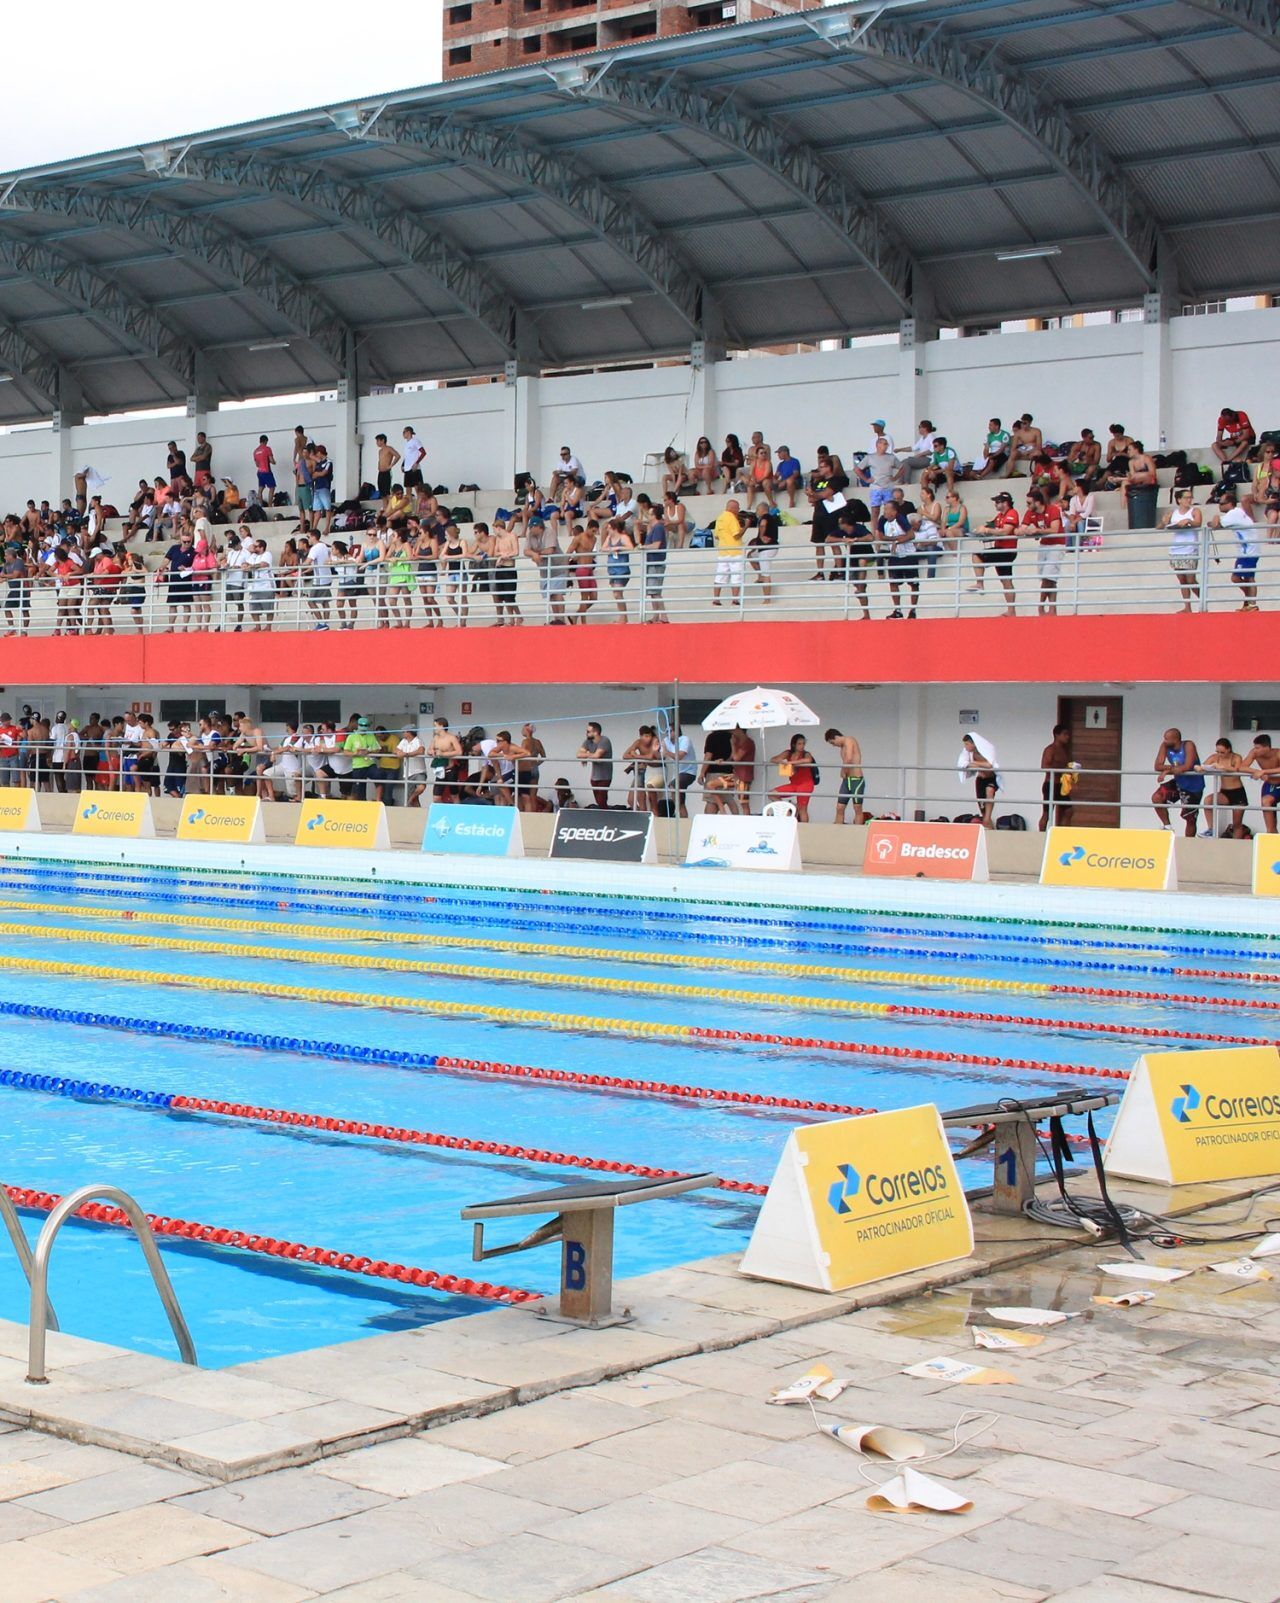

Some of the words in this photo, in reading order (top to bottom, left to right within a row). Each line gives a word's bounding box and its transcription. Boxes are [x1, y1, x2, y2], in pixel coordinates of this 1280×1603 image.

[97, 809, 135, 822] Correios
[204, 814, 246, 827] Correios
[324, 819, 369, 833] Correios
[455, 822, 505, 838] Estácio
[558, 826, 615, 843] speedo
[901, 843, 970, 860] Bradesco
[1086, 853, 1156, 870] Correios
[1195, 1132, 1259, 1147] PATROCINADOR
[999, 1146, 1016, 1186] 1
[865, 1164, 947, 1206] Correios
[856, 1215, 924, 1243] PATROCINADOR
[925, 1207, 955, 1225] OFICIAL
[566, 1241, 586, 1291] B
